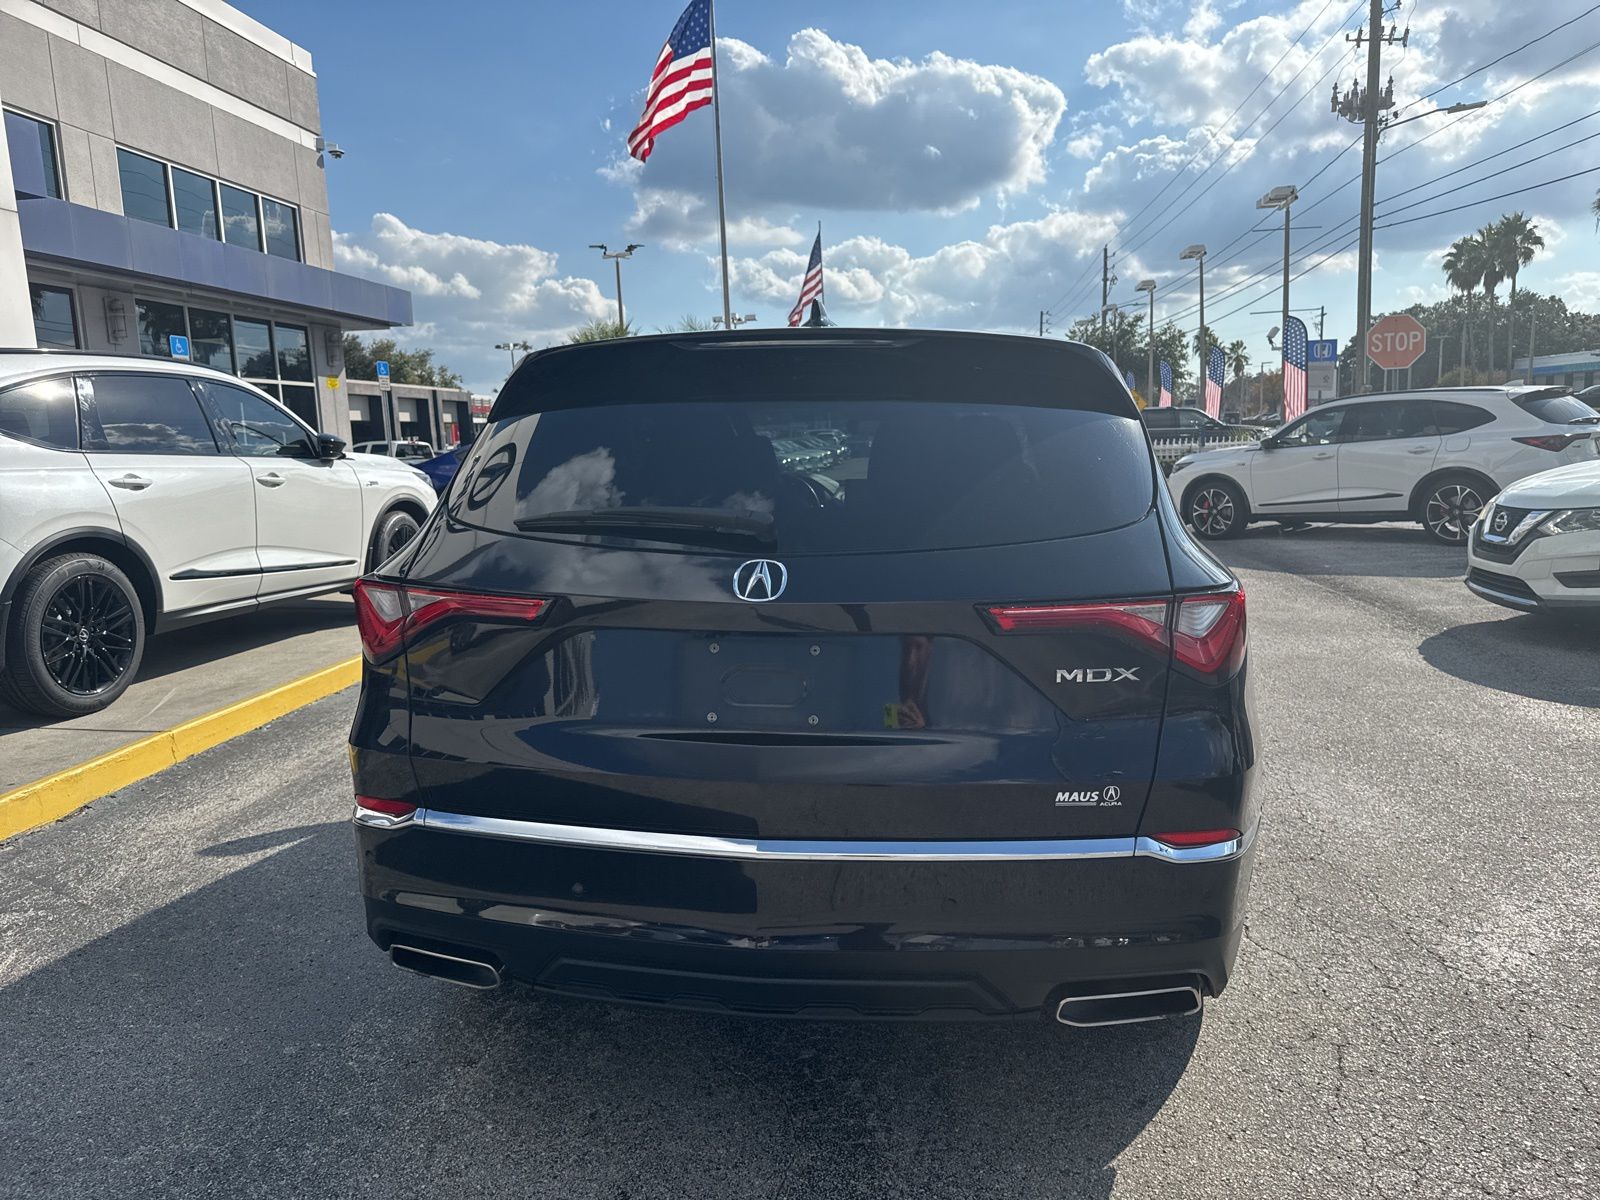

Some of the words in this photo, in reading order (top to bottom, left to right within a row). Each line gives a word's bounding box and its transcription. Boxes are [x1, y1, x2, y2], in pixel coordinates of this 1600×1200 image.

[1371, 331, 1421, 352] STOP
[1056, 667, 1141, 683] MDX
[1055, 791, 1099, 802] MAUS
